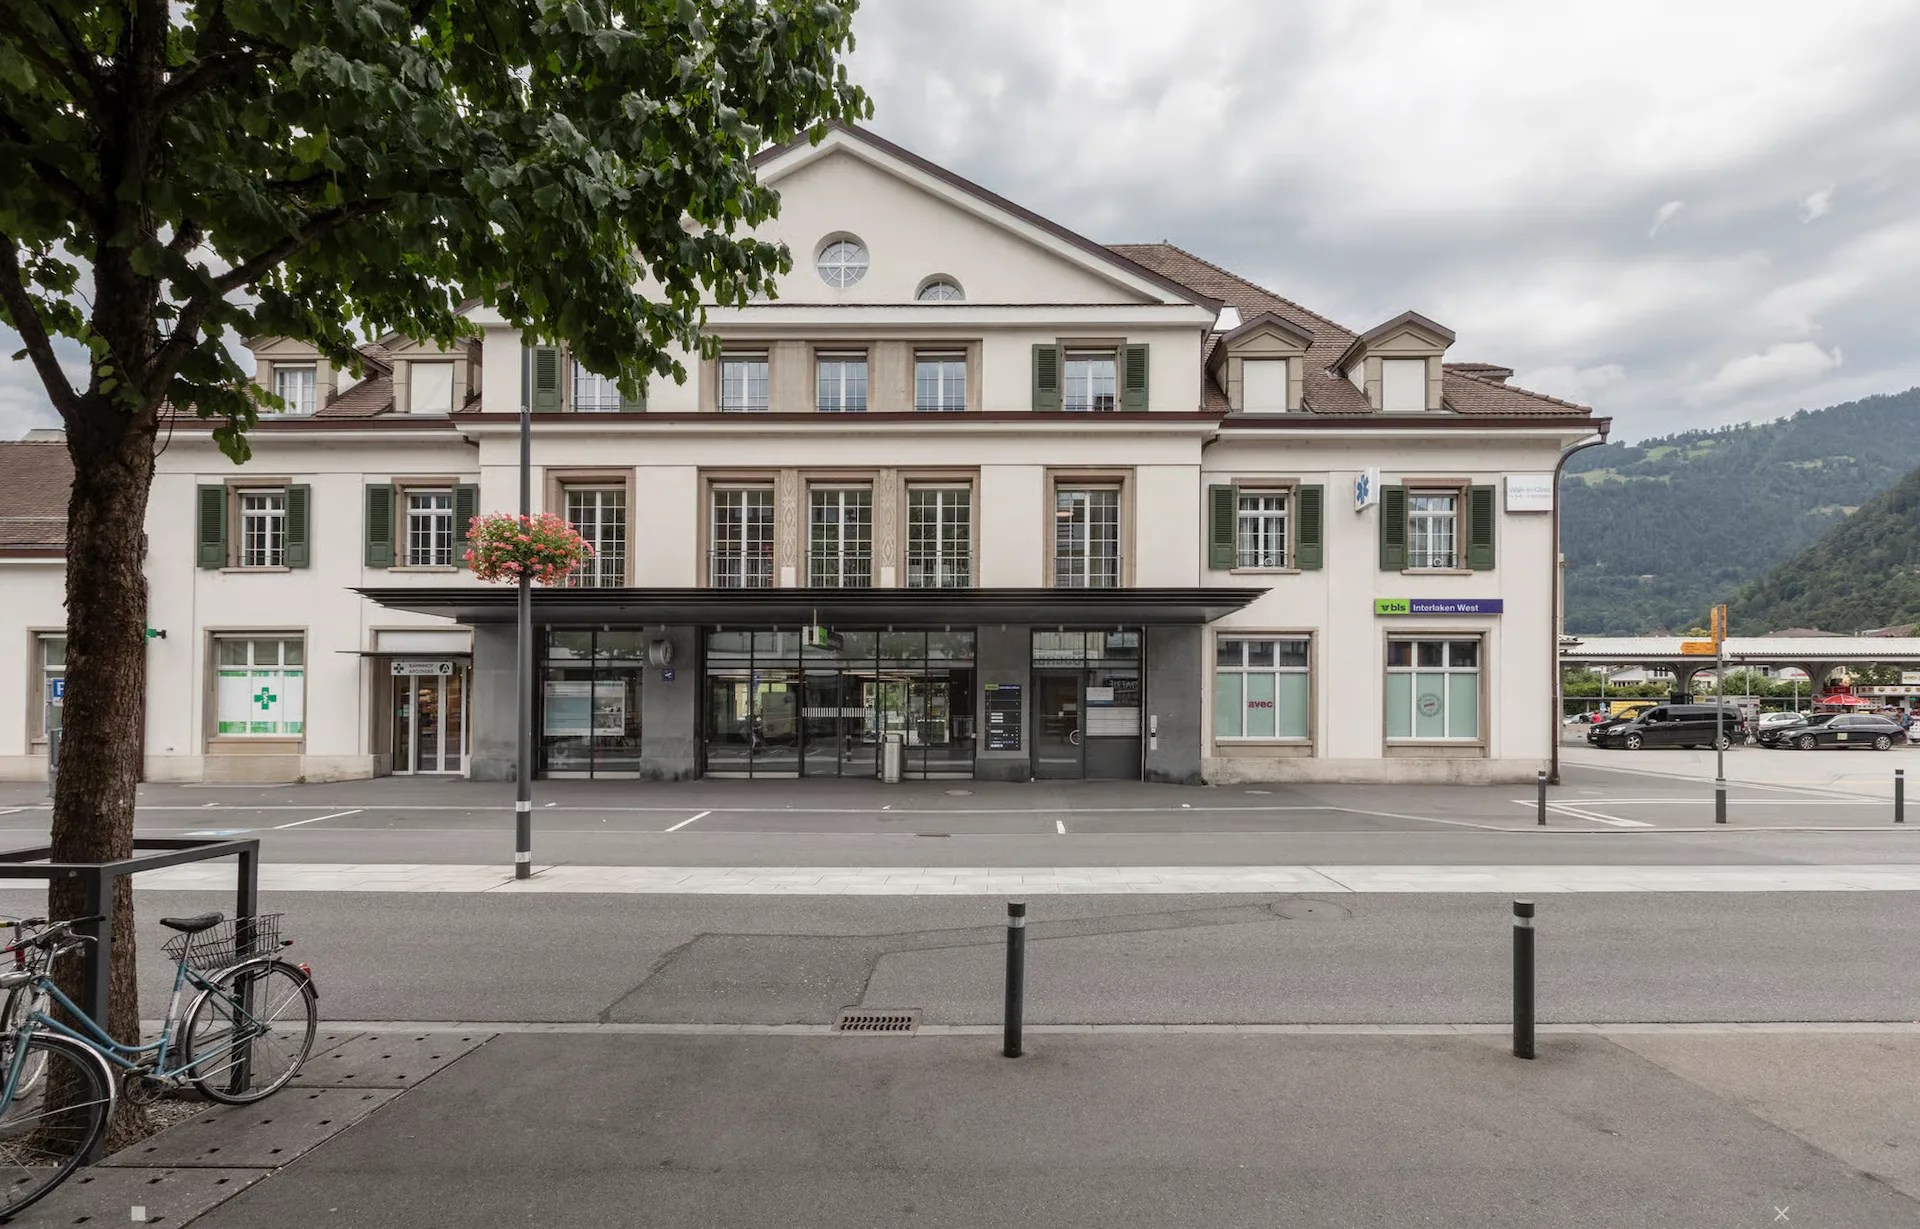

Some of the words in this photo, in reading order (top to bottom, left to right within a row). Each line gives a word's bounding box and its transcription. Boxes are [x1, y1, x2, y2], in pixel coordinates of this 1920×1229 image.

[1390, 603, 1406, 612] bls
[1413, 603, 1455, 612] Interlaken
[1456, 603, 1479, 612] West
